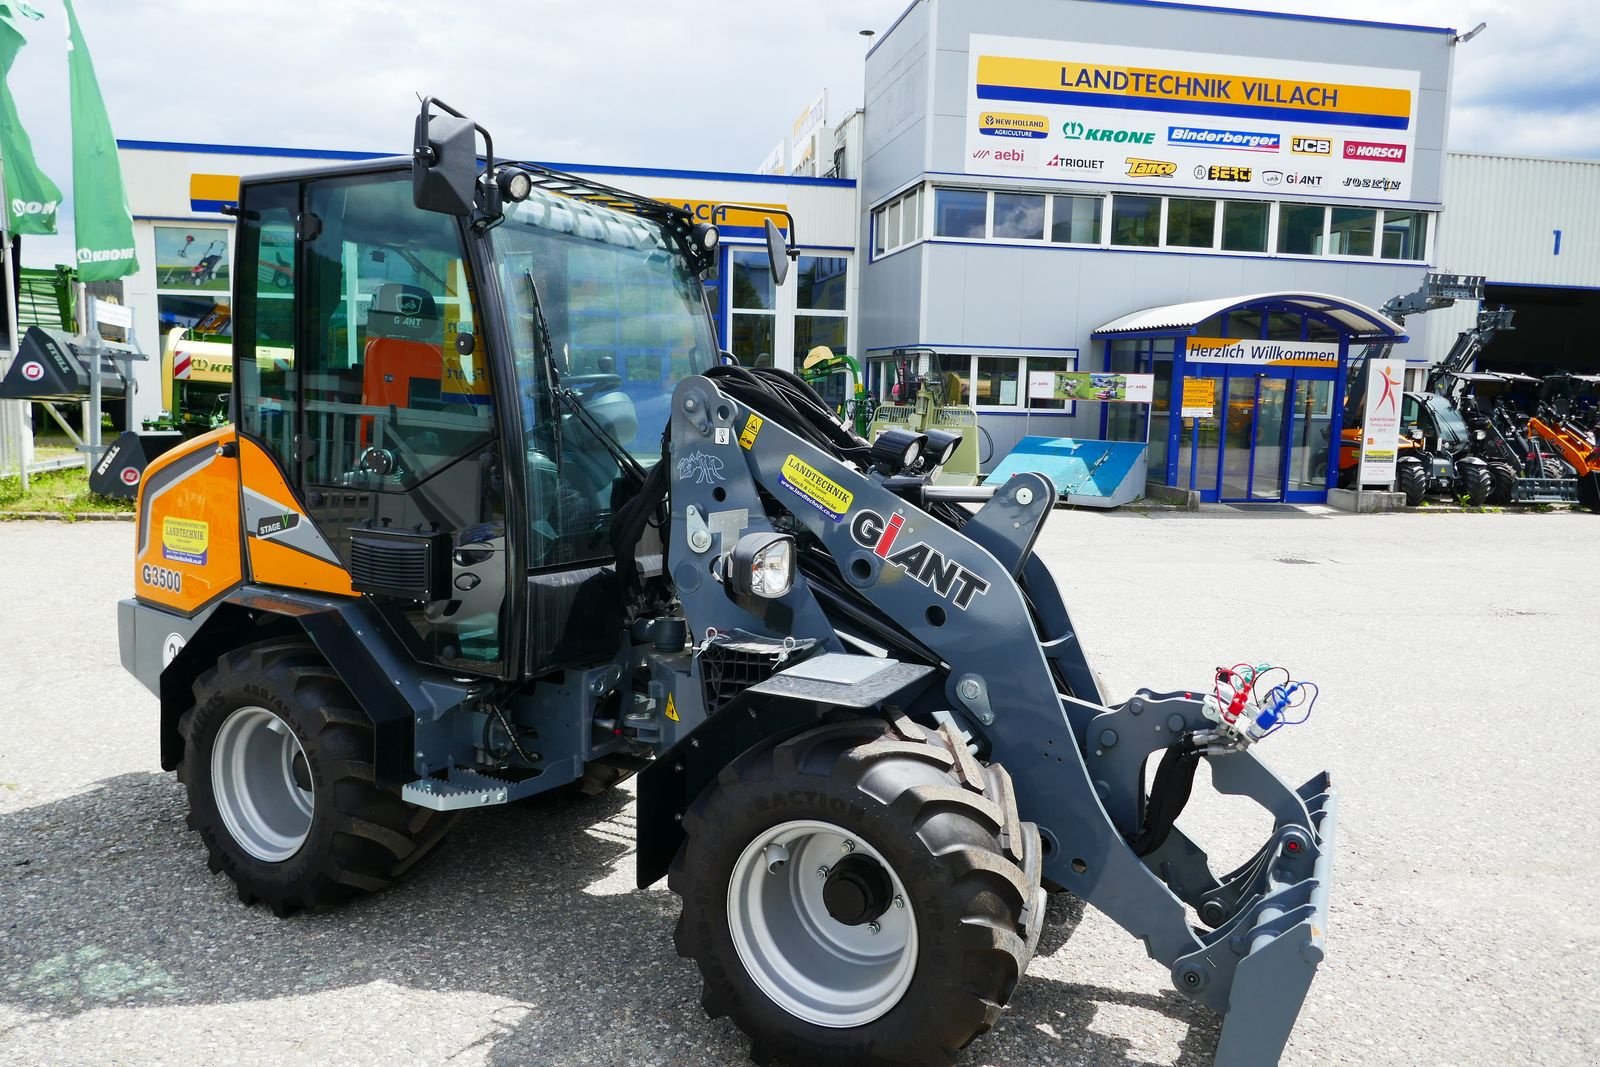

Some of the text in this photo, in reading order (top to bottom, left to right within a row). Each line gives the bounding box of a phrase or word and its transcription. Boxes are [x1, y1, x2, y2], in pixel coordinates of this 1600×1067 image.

[1060, 66, 1338, 108] LANDTECHNIK VILLACH
[995, 118, 1044, 128] NEW HOLLAND
[994, 129, 1032, 138] AGRICULTURE
[1085, 128, 1156, 145] KRONE
[1170, 128, 1278, 146] Binderberger
[1293, 139, 1330, 153] JCB
[1356, 146, 1403, 158] HORSCH
[994, 149, 1024, 162] aebi
[1059, 158, 1104, 169] TRIOLIET
[1125, 157, 1178, 178] Tanco
[1190, 344, 1335, 362] Herzlich Willkommen
[97, 446, 120, 476] STOLL
[788, 458, 850, 504] LANDTECHNIK
[788, 475, 804, 488] Villach
[780, 480, 837, 520] www.landtechnik.co.at
[260, 508, 290, 534] STAGE V
[166, 526, 204, 541] LANDTECHNIK
[142, 564, 180, 592] G3500
